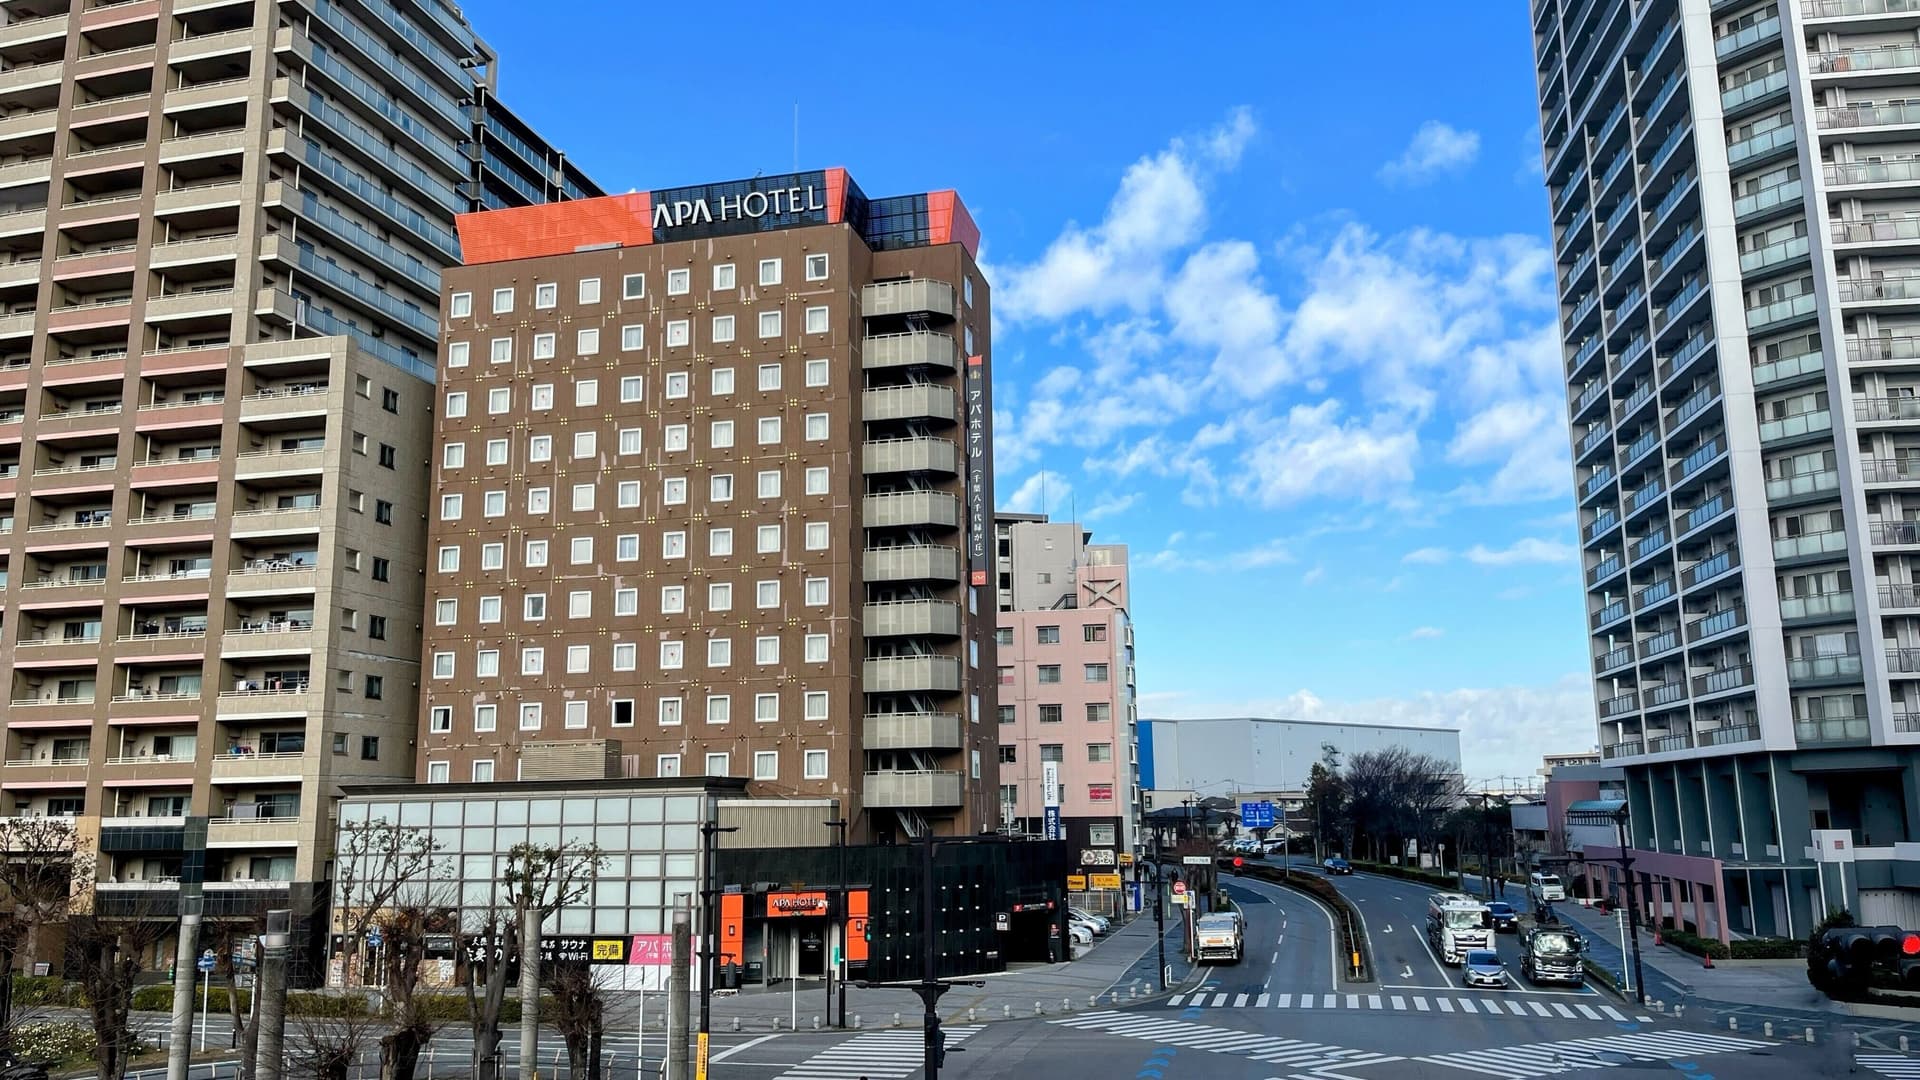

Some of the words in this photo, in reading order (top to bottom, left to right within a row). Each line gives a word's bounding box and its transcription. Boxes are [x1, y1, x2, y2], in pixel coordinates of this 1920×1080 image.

[653, 198, 713, 229] APA
[720, 185, 824, 222] HOTEL
[970, 390, 982, 458] アパホテル
[1047, 810, 1056, 840] 株式会社
[772, 899, 791, 907] APA
[792, 898, 820, 906] HOTE
[560, 939, 587, 950] サウナ
[597, 945, 619, 956] 完備
[568, 952, 588, 961] Wi-Fi
